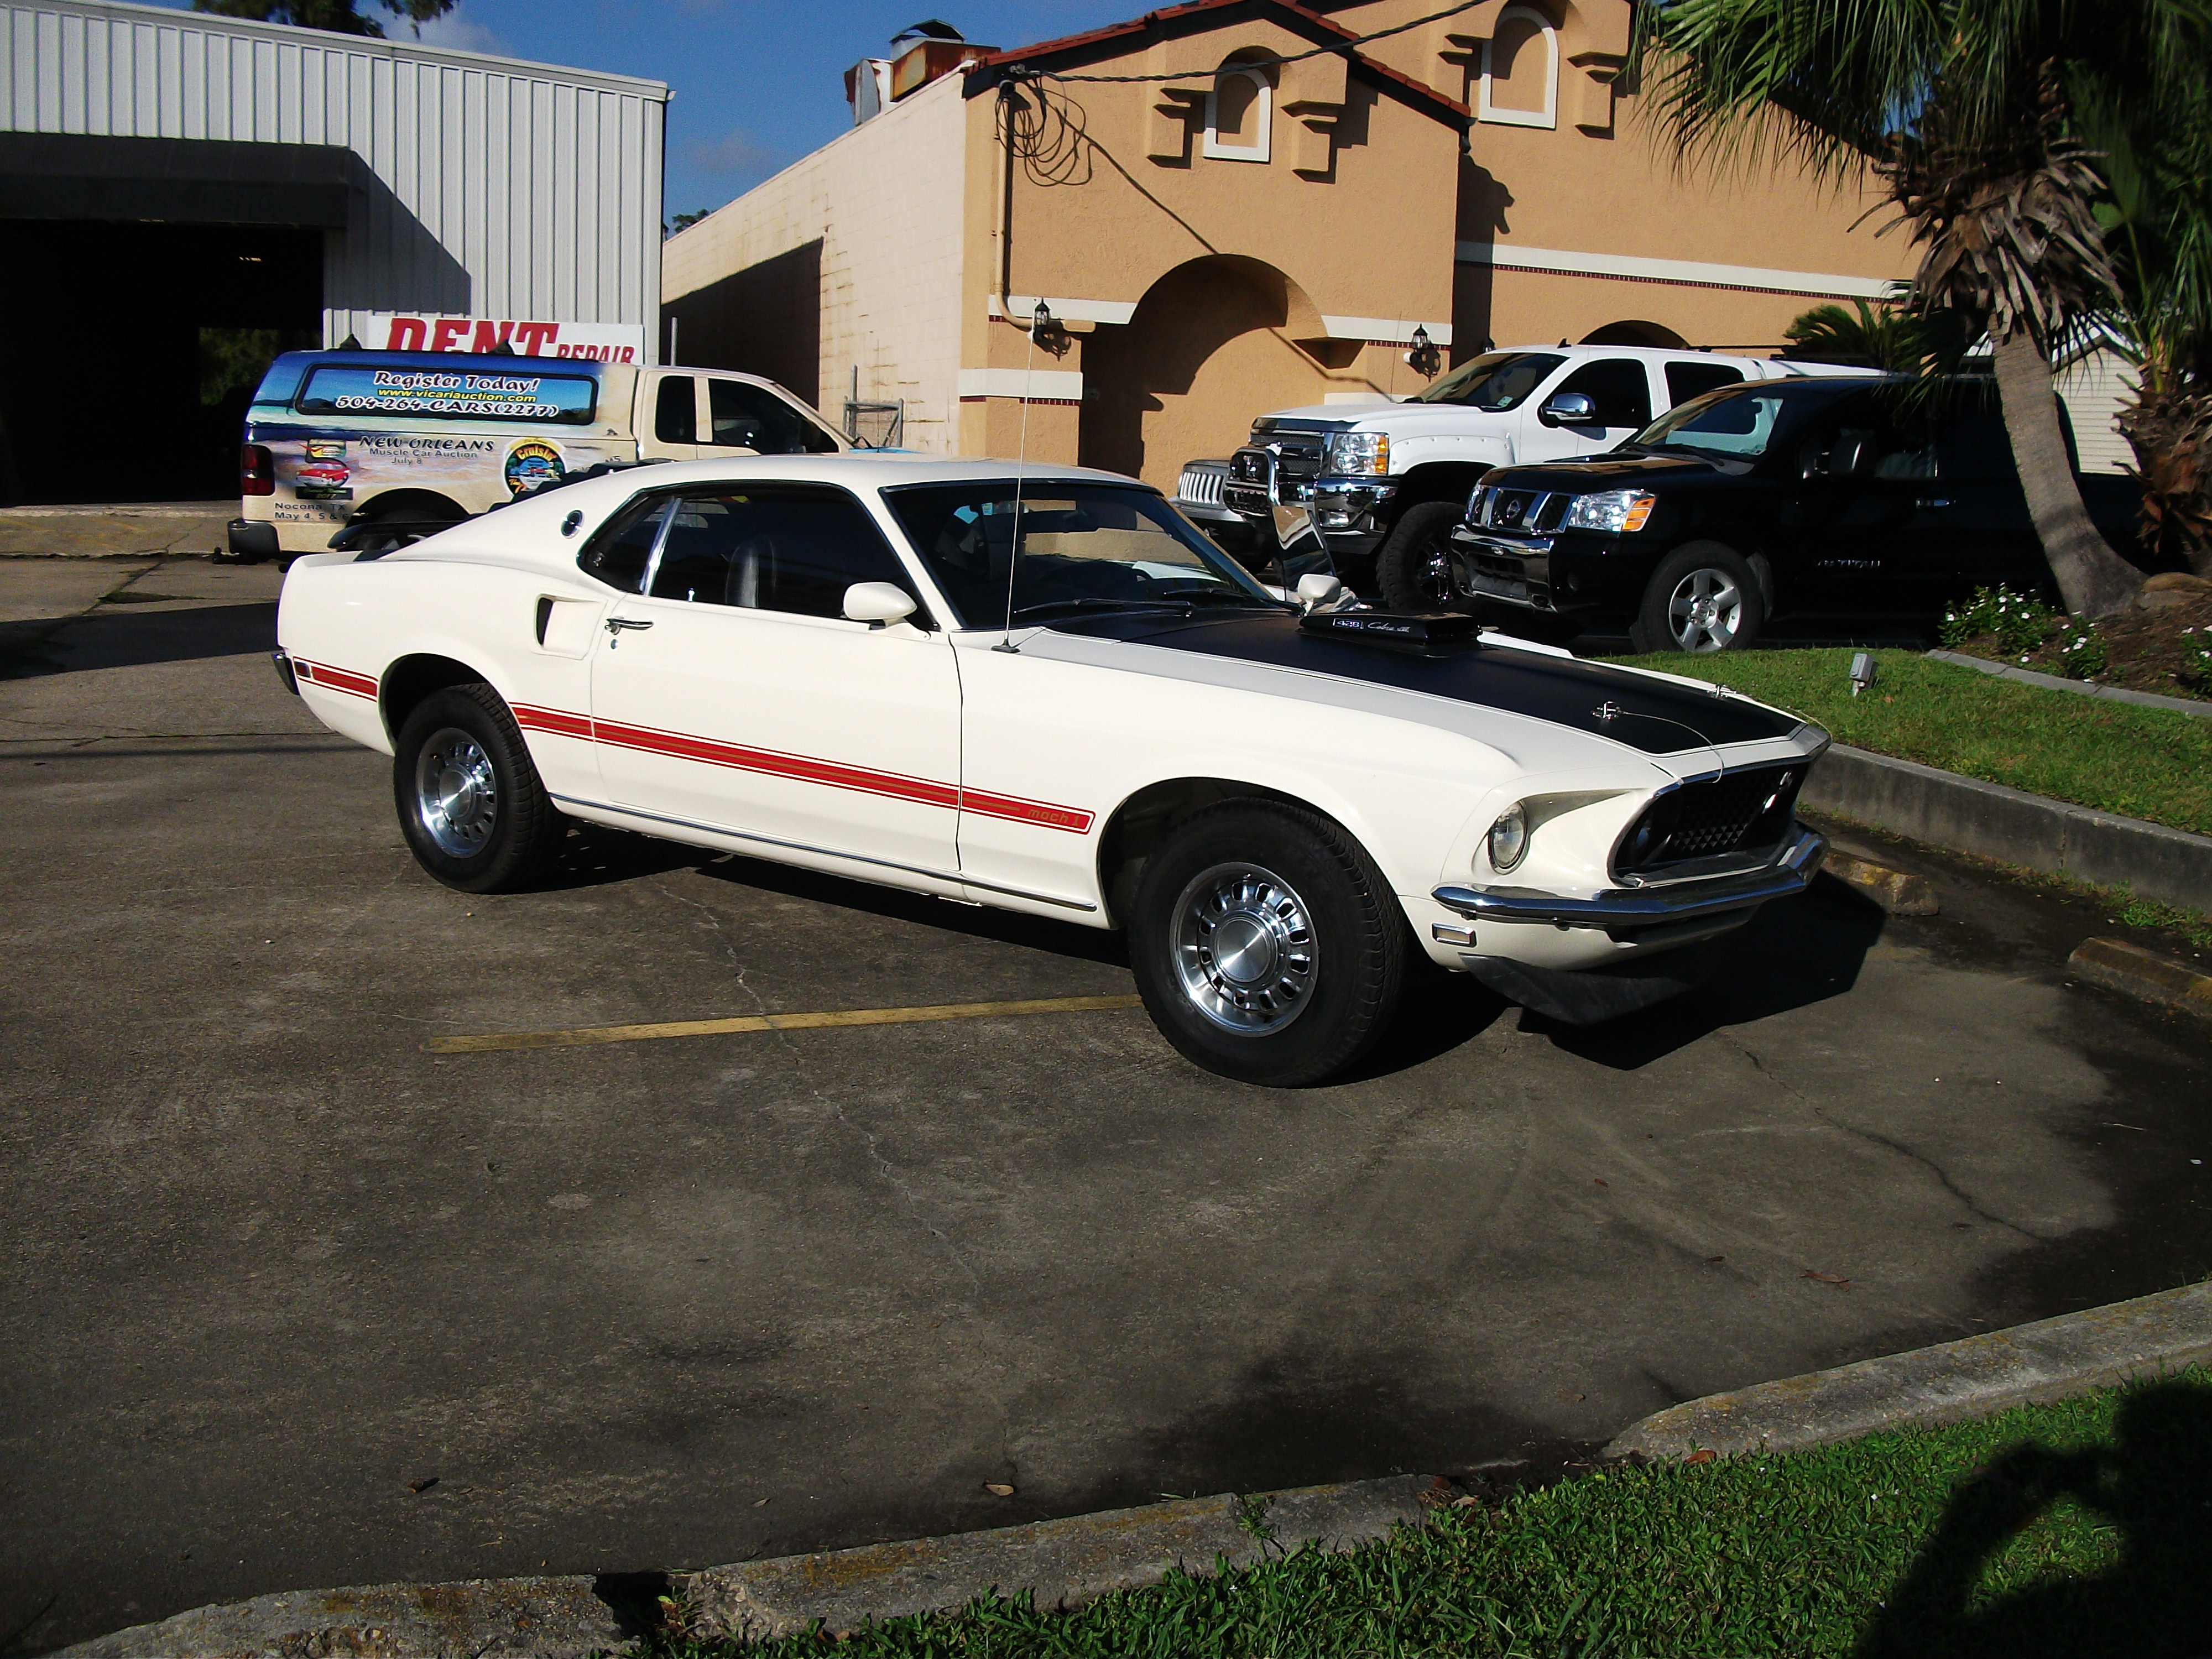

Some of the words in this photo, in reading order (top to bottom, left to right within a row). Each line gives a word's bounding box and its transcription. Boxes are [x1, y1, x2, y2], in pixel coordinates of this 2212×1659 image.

[387, 318, 560, 355] DENT
[374, 371, 461, 389] Register
[466, 375, 540, 394] Today!
[378, 389, 536, 403] www.vicariauction.com
[336, 395, 559, 417] 504-264-CARS(2277)
[359, 436, 403, 447] NEW
[408, 438, 494, 451] ORLEANS
[275, 512, 299, 520] May
[1027, 808, 1069, 825] mach
[1072, 815, 1080, 827] 1
